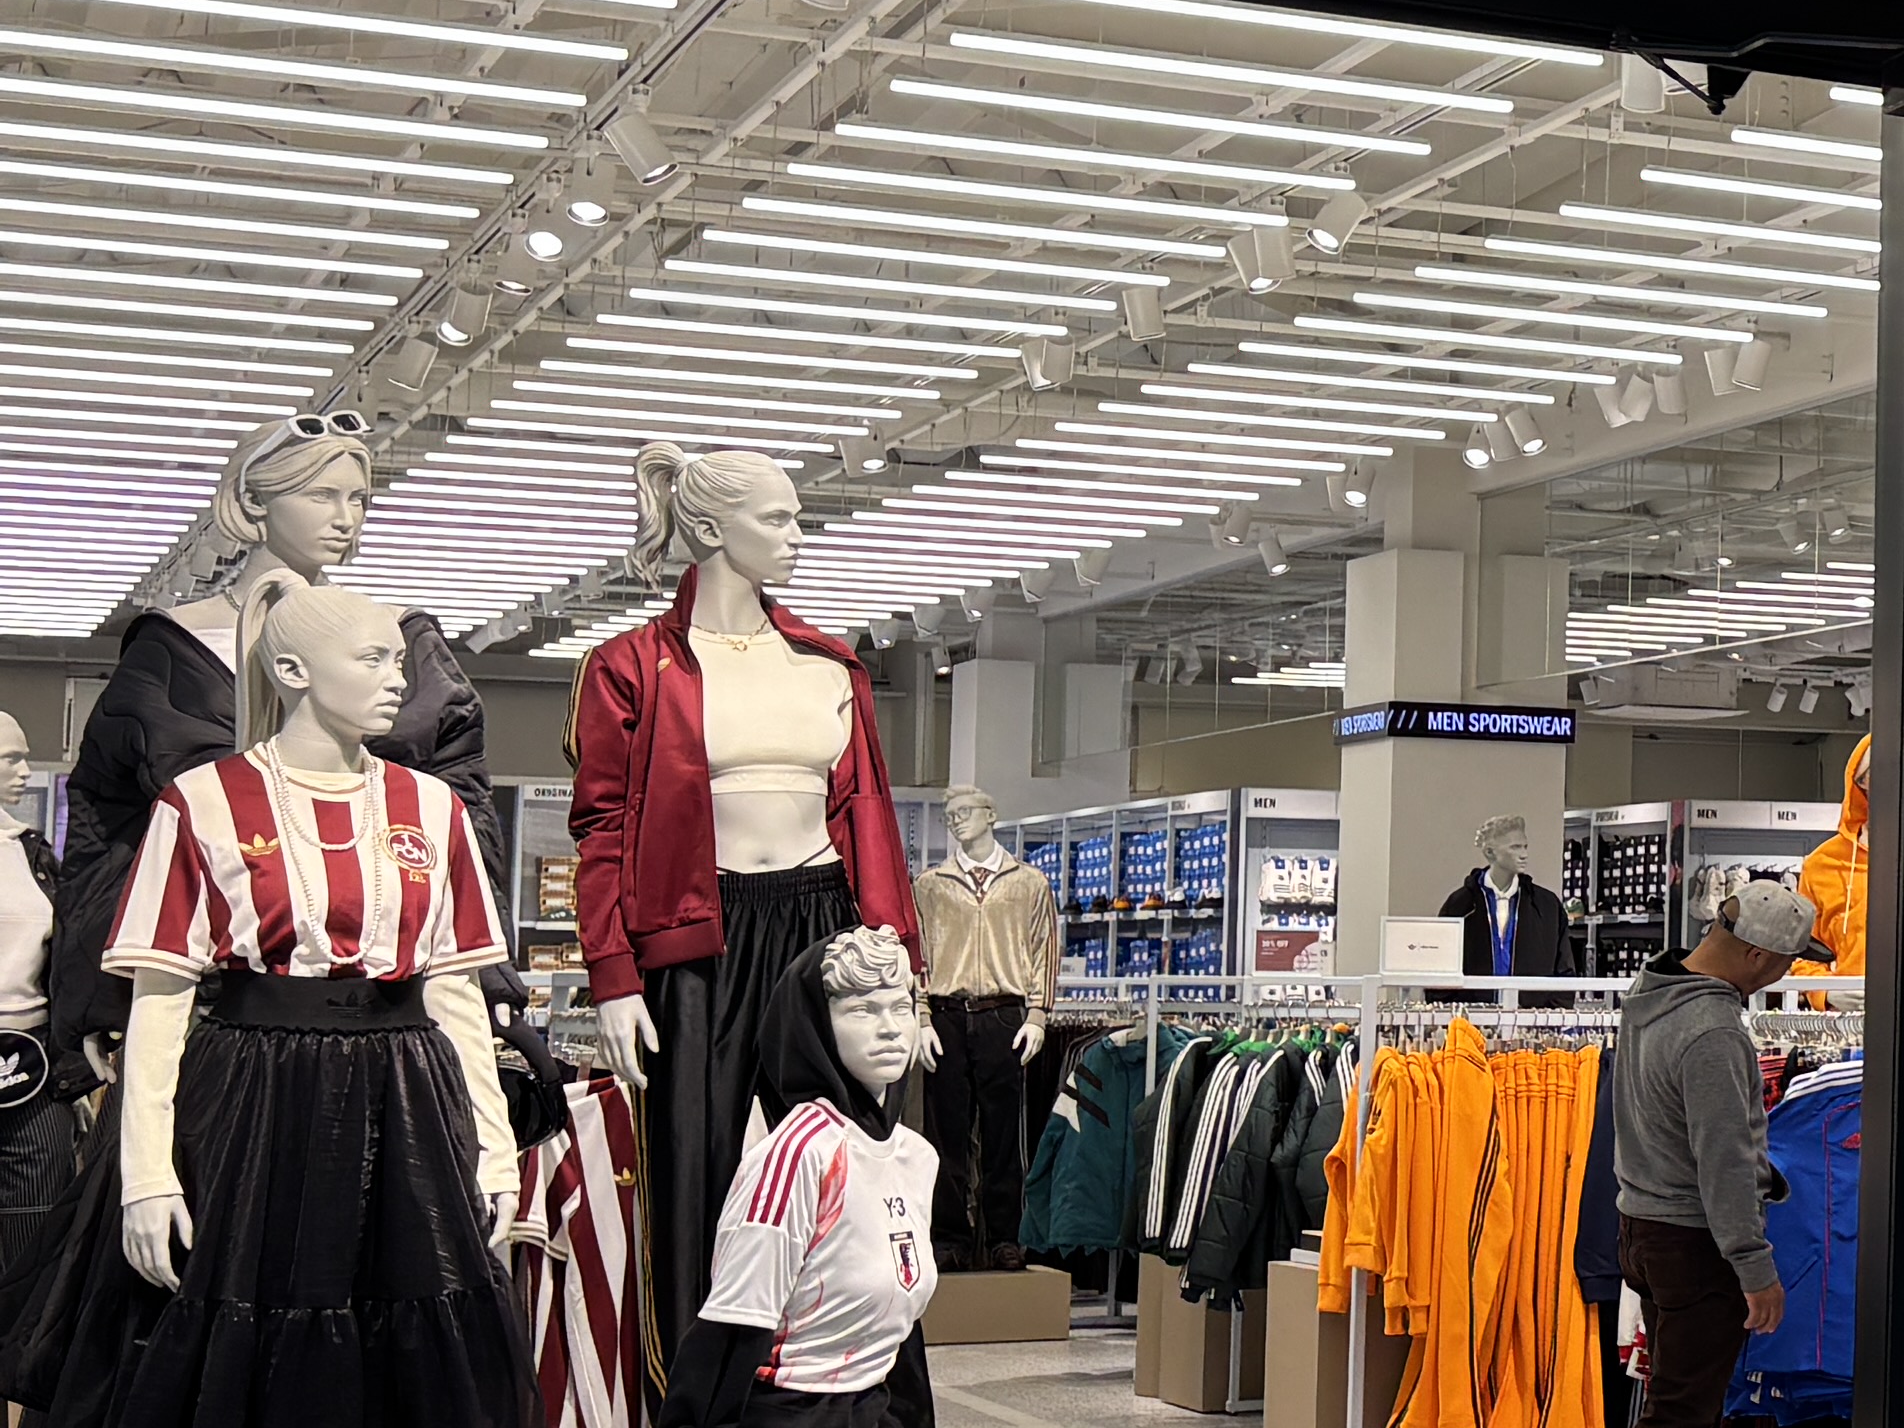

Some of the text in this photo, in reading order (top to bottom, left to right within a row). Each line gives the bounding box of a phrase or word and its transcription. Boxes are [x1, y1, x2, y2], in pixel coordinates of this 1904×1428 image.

[1427, 712, 1464, 731] MEN
[1468, 713, 1571, 736] SPORTSWEAR
[1254, 797, 1277, 809] MEN
[1697, 808, 1718, 819] MEN
[1777, 810, 1798, 821] MEN
[883, 1196, 906, 1218] Y-3
